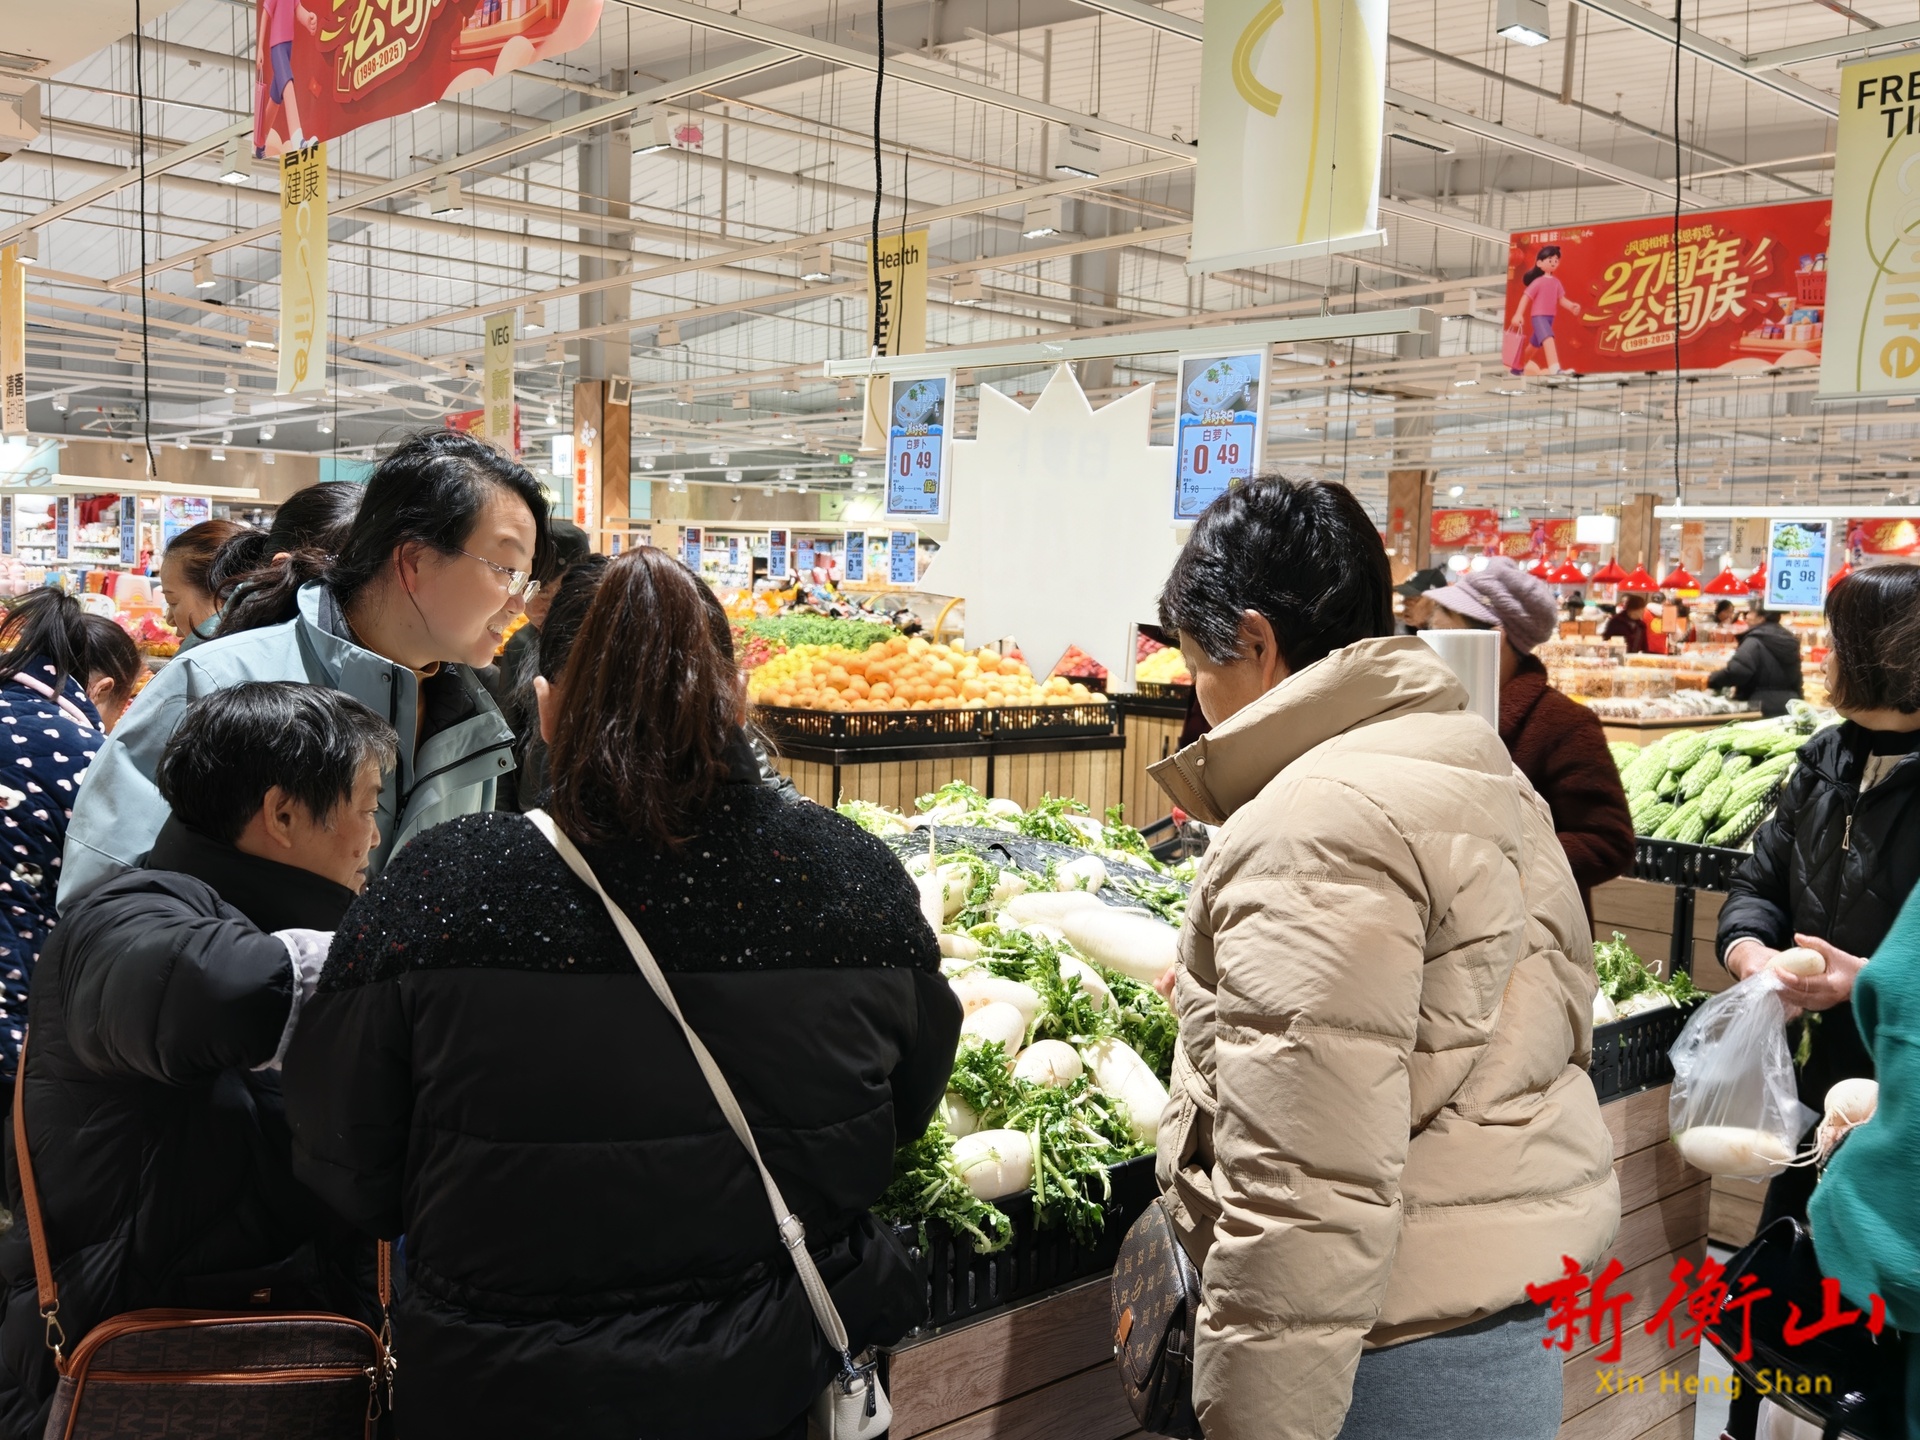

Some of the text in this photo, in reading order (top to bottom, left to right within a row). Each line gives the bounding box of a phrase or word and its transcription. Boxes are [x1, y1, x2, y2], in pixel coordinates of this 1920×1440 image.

[349, 0, 440, 61] 公司
[355, 40, 405, 88] (1998-2025)
[1880, 104, 1920, 139] TI
[284, 162, 320, 209] 健康
[1624, 233, 1669, 257] 风雨相伴
[1597, 237, 1742, 308] 27周年
[1618, 271, 1750, 340] 公司庆
[490, 325, 510, 347] VEG
[1202, 408, 1235, 425] 美好冬日
[1202, 428, 1232, 442] 白萝卜
[1183, 482, 1200, 494] 1.98
